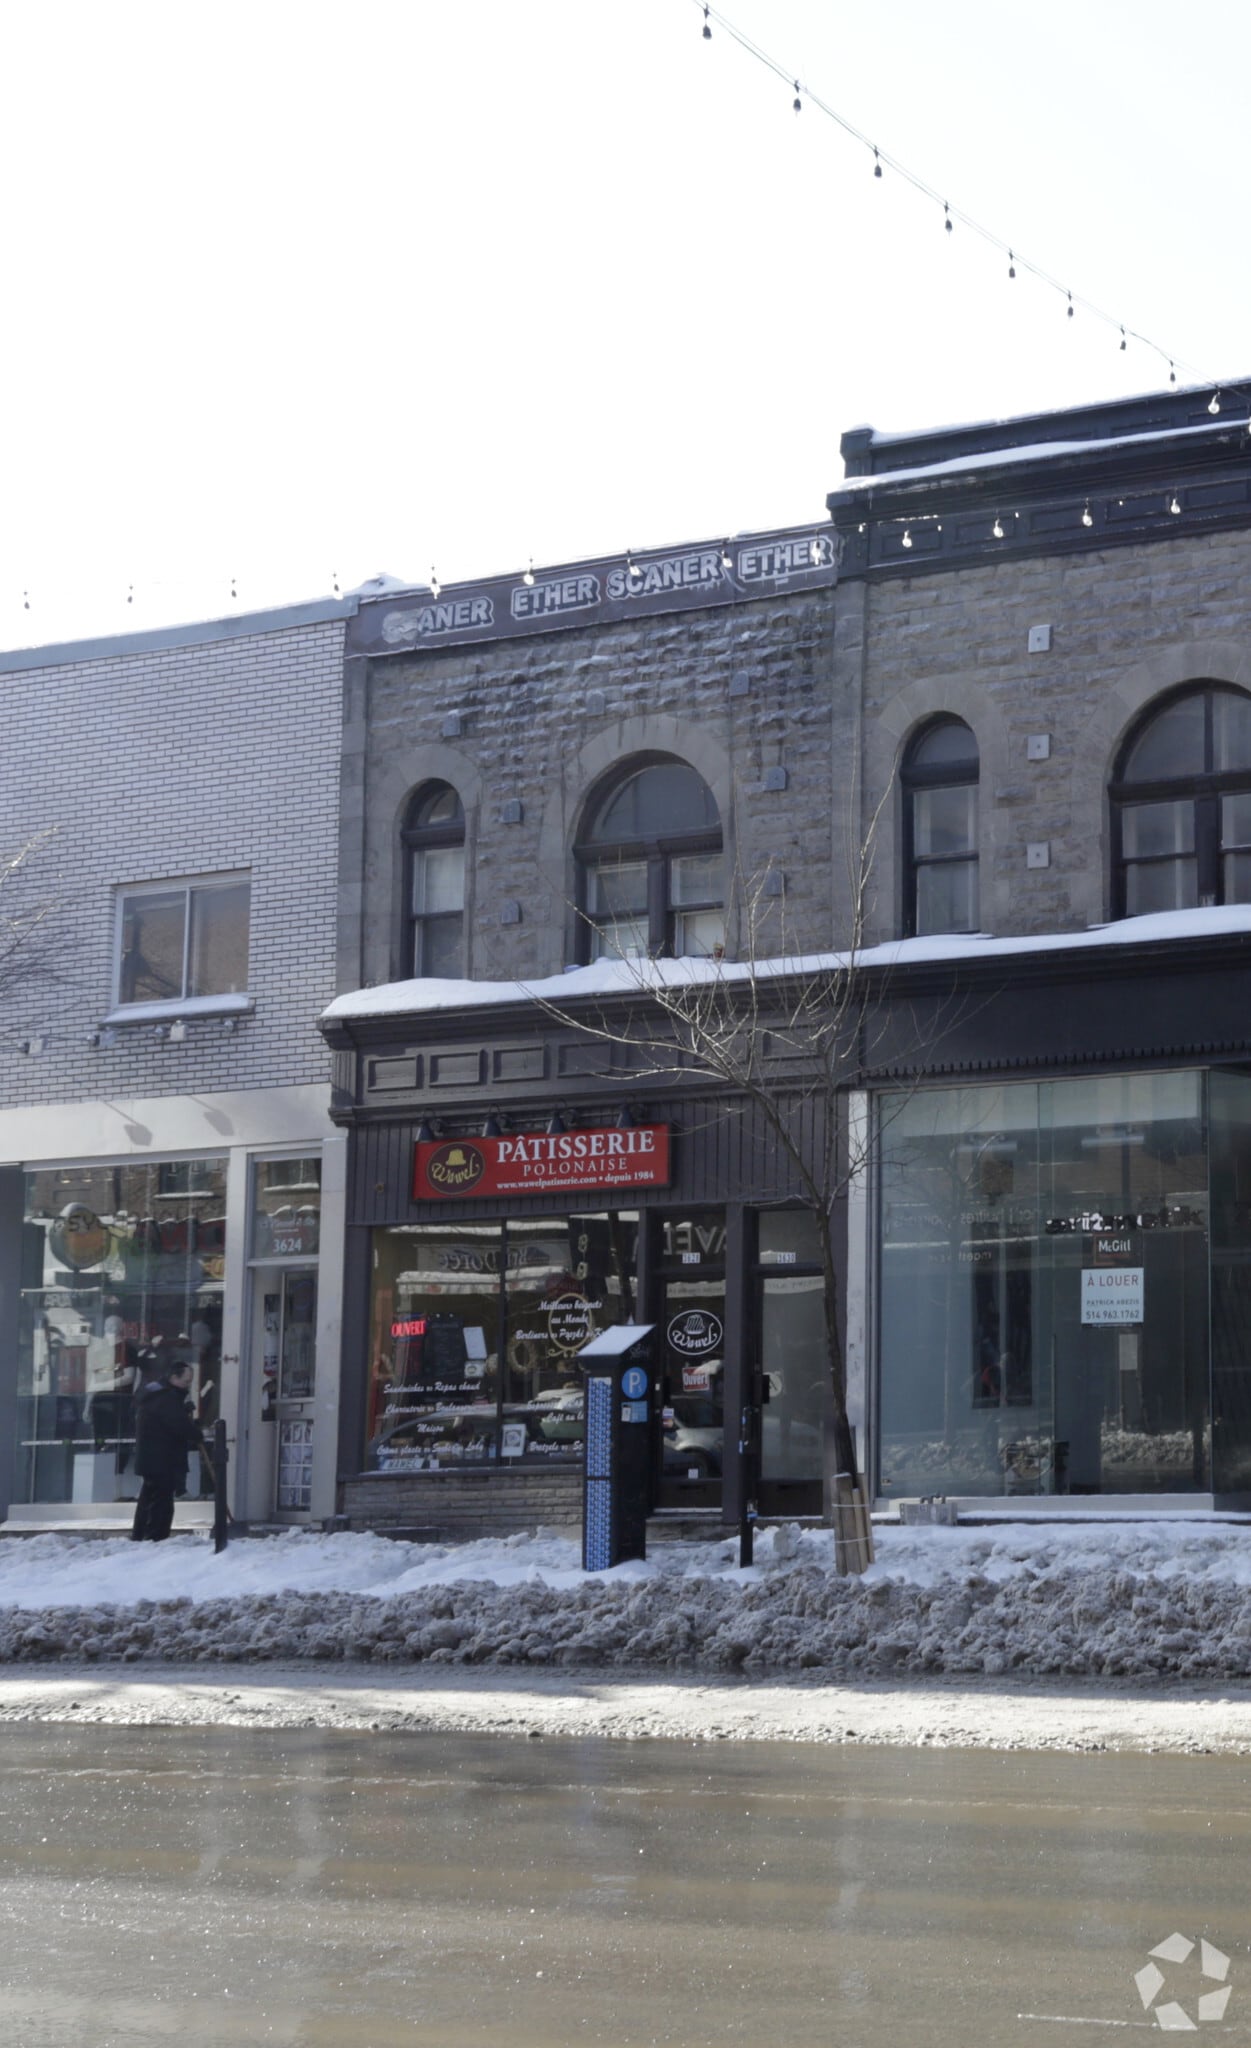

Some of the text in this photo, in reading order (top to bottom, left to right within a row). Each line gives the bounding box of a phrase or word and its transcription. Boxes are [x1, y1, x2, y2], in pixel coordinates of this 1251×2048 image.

[512, 577, 597, 617] ETHER
[607, 552, 722, 598] SCANER
[740, 540, 829, 579] ETHER
[496, 1130, 655, 1162] PÂTISSERIE
[431, 1152, 481, 1184] Wawel
[523, 1158, 628, 1177] POLONAISE
[604, 1173, 632, 1184] depuis
[273, 1237, 302, 1253] 3624
[1098, 1239, 1131, 1252] McGill
[1087, 1273, 1139, 1287] À LOUER
[391, 1320, 426, 1337] OUVERT
[683, 1372, 708, 1386] Ouvert
